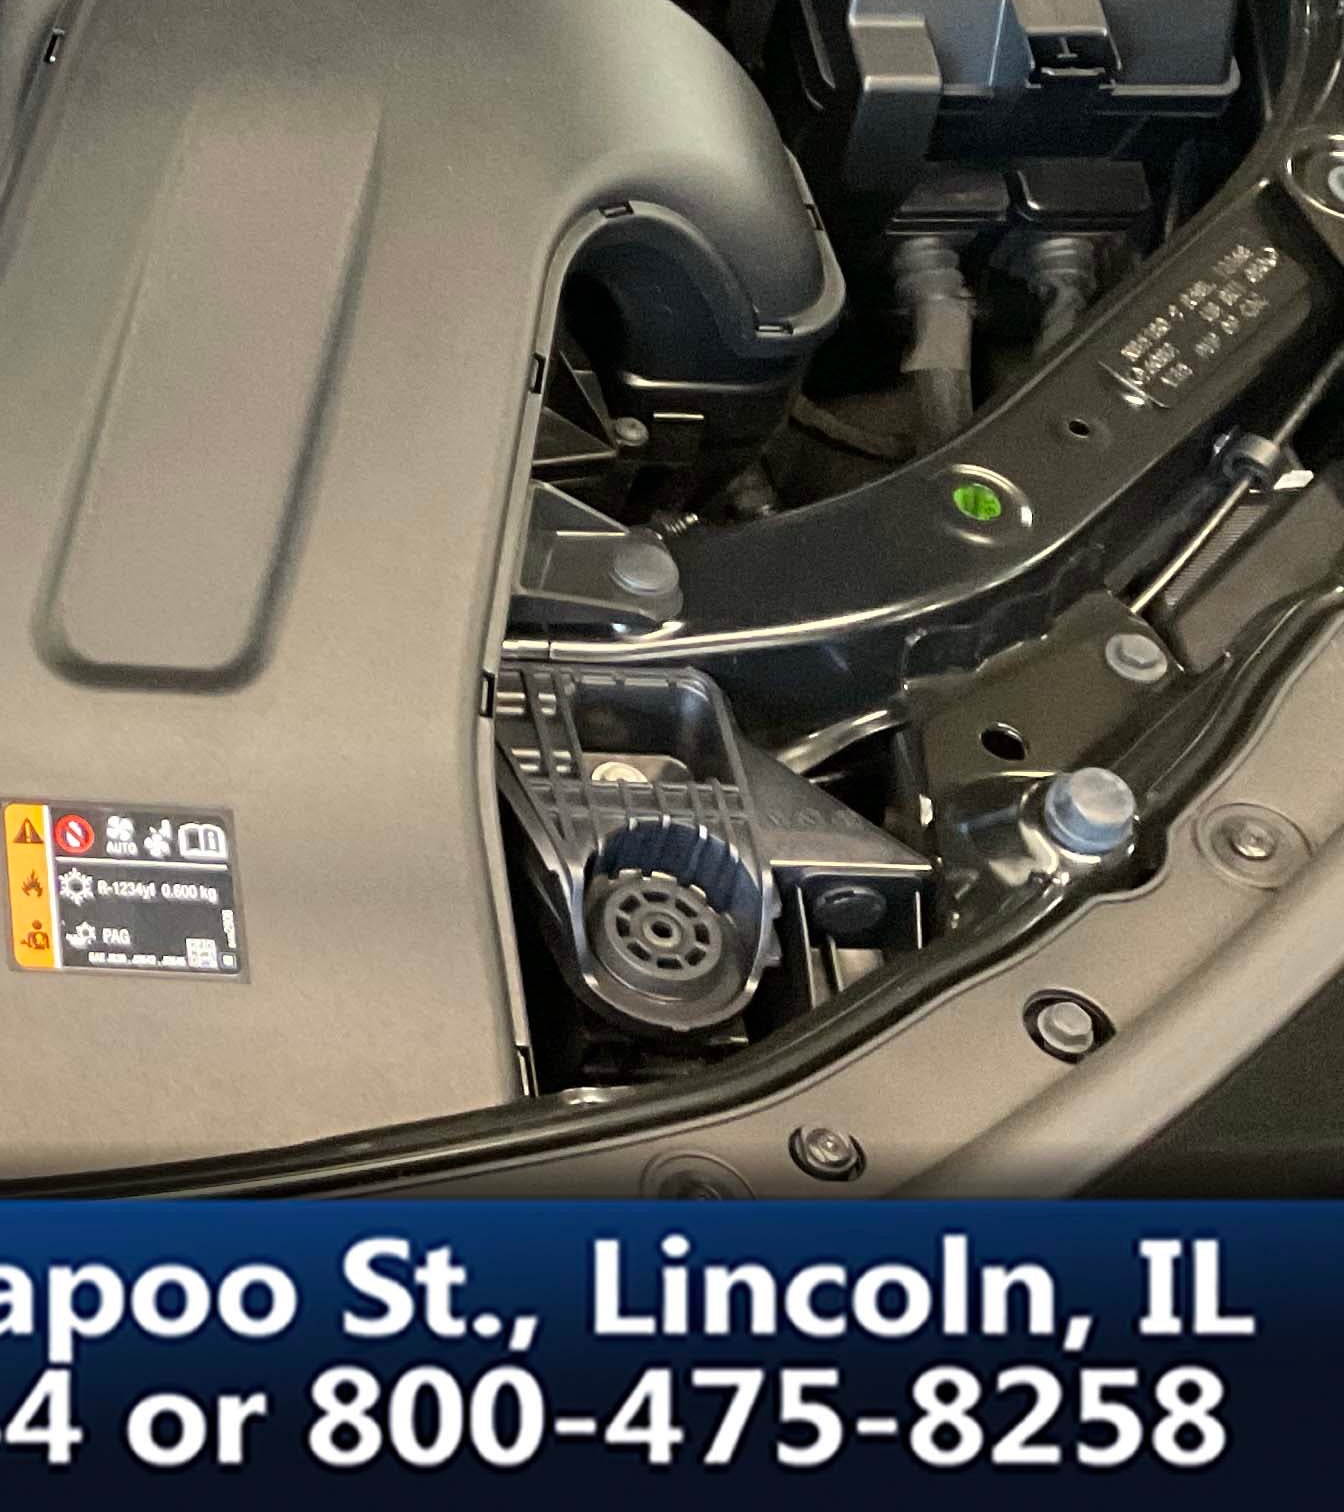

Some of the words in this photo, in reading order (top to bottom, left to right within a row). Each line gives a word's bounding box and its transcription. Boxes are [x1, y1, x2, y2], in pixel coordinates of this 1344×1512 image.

[105, 842, 139, 856] AUTO
[97, 878, 156, 899] R-1234yf
[199, 884, 218, 904] kg
[101, 926, 132, 945] PAG
